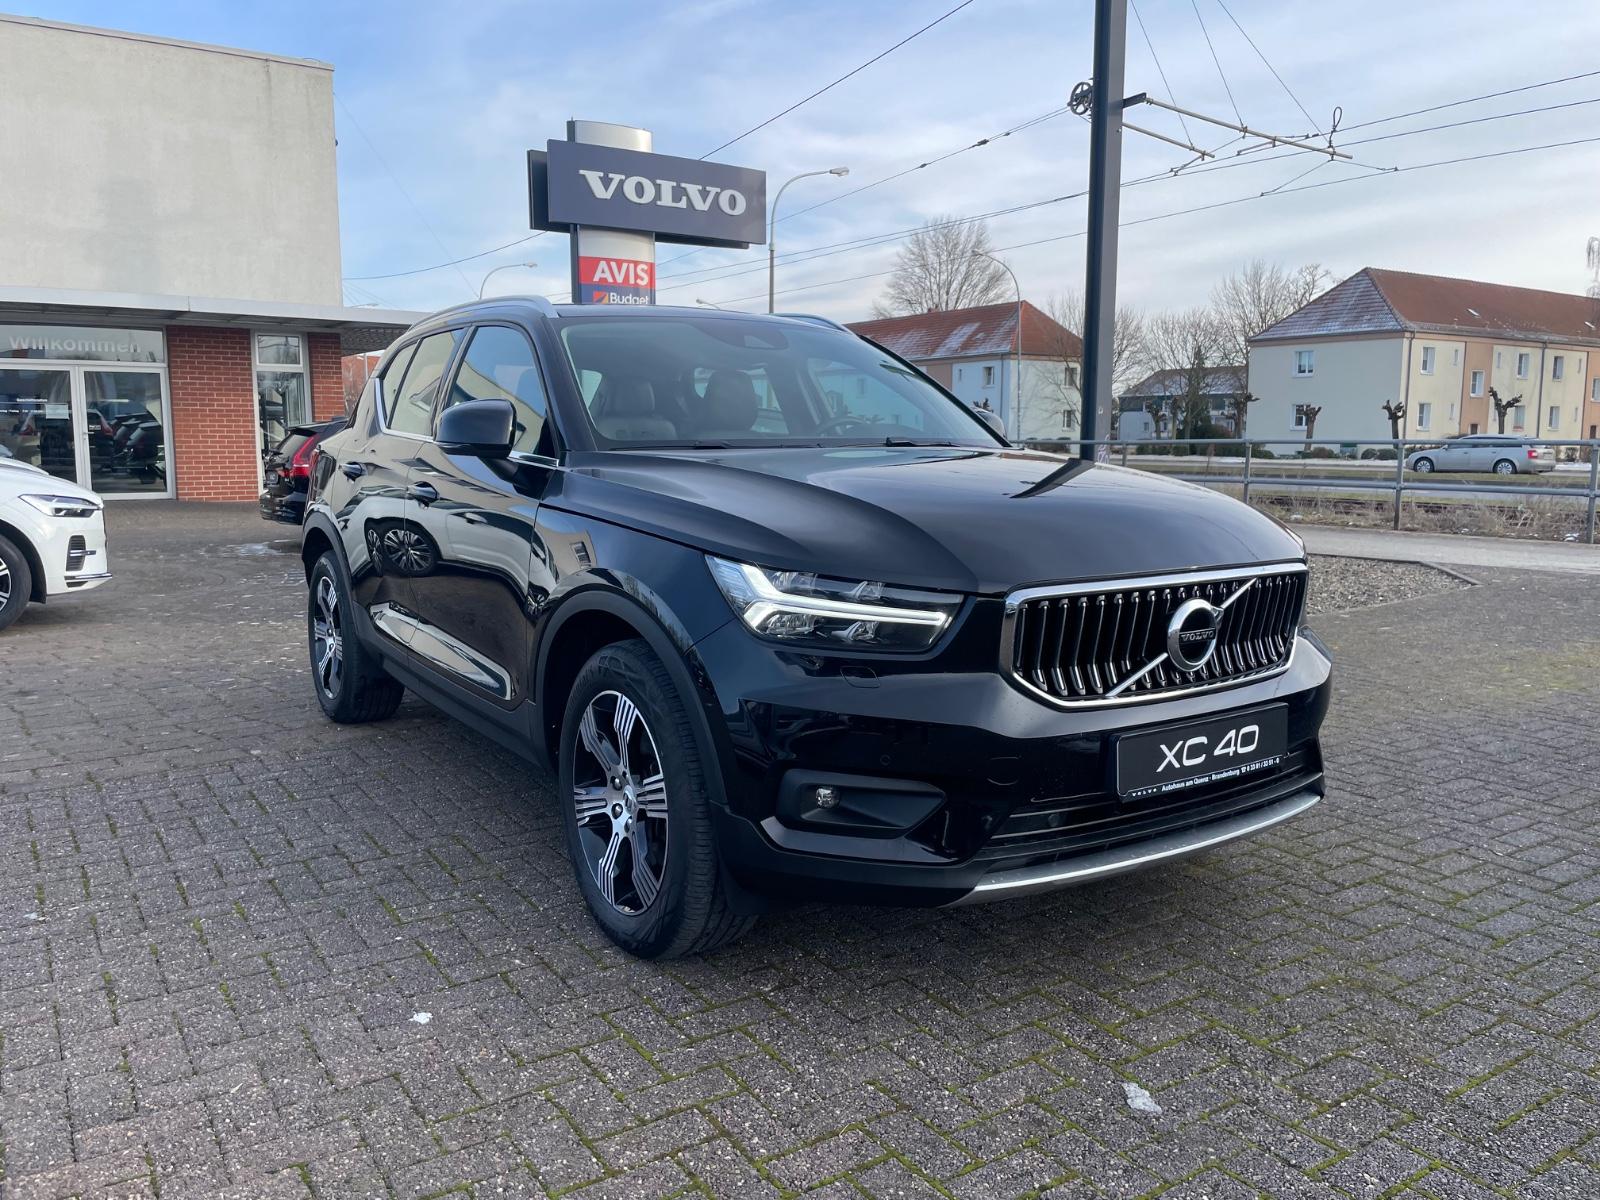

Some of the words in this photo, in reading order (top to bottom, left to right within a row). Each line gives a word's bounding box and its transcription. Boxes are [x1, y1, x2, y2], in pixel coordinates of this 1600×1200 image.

[579, 169, 747, 216] VOLVO
[593, 260, 649, 286] AVIS
[9, 335, 142, 353] Willkommen
[1180, 630, 1214, 642] VOLVO
[1156, 736, 1208, 772] XC
[1213, 724, 1260, 757] 40
[1161, 782, 1185, 792] Autohaus
[1211, 769, 1240, 781] Brandenburg
